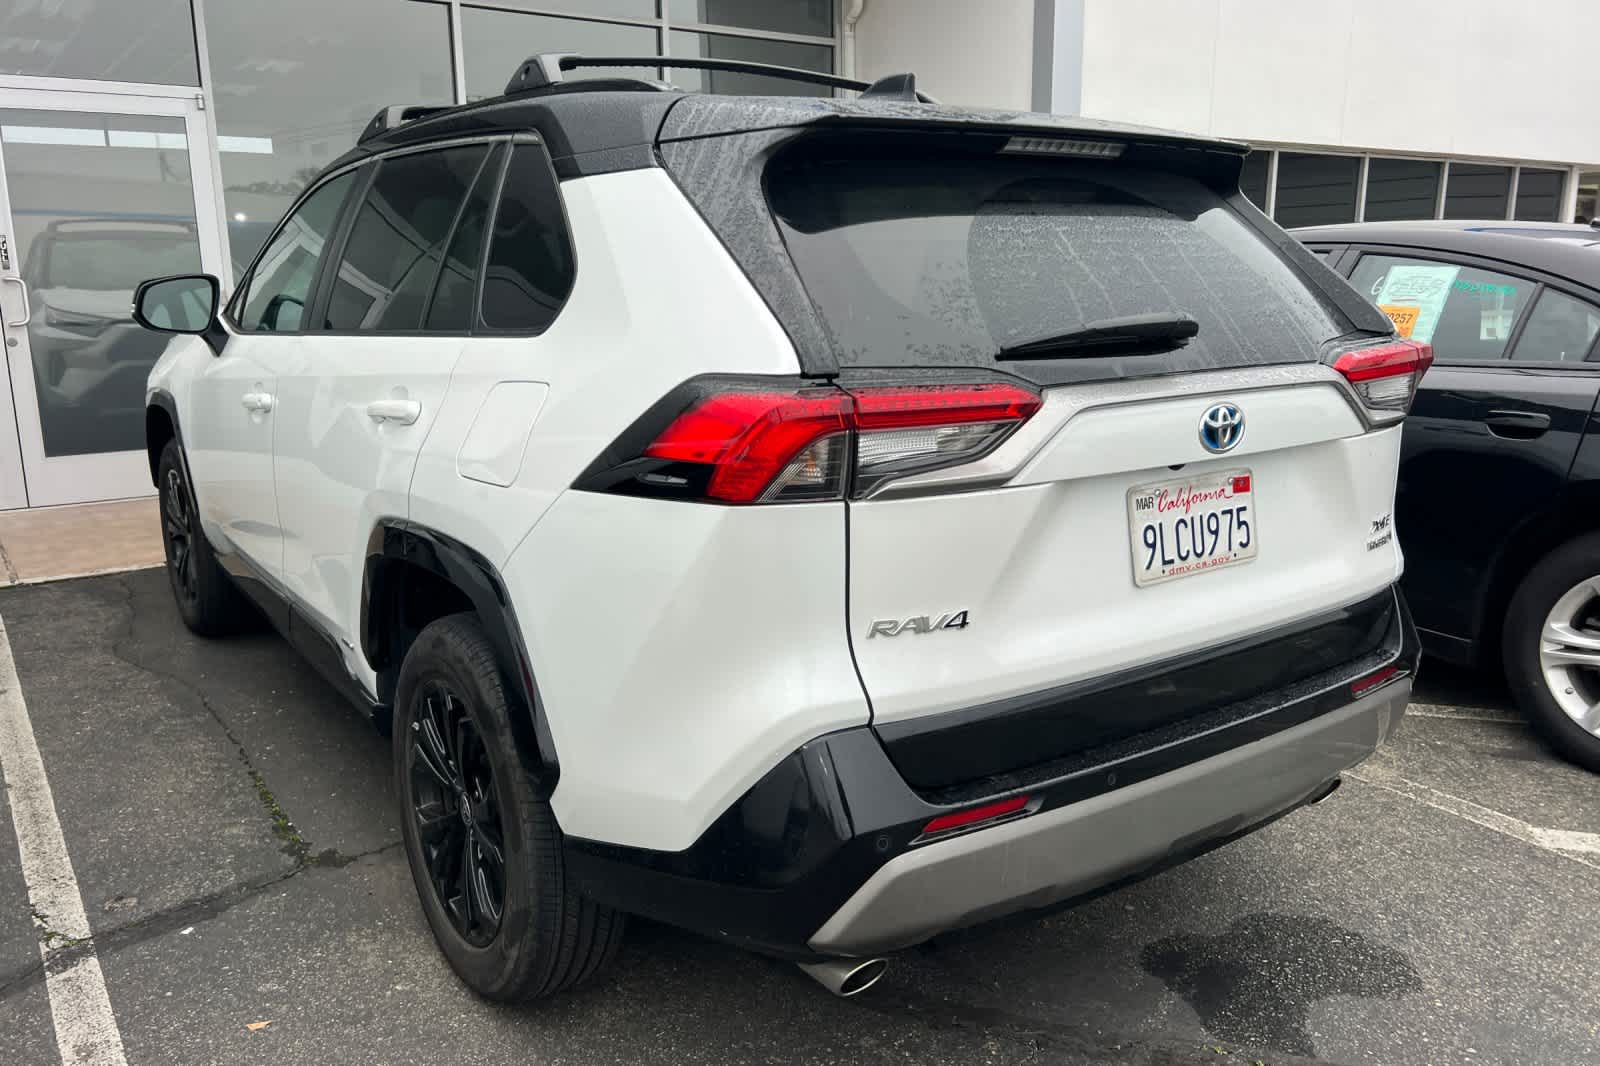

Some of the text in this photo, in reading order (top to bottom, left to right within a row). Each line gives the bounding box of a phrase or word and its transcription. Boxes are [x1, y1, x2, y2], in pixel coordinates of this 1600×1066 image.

[1135, 496, 1155, 511] MAR
[1157, 485, 1233, 514] California
[1142, 505, 1251, 571] 9LCU975
[1167, 555, 1232, 577] dmv.ca.gov
[865, 608, 970, 640] RAV4
